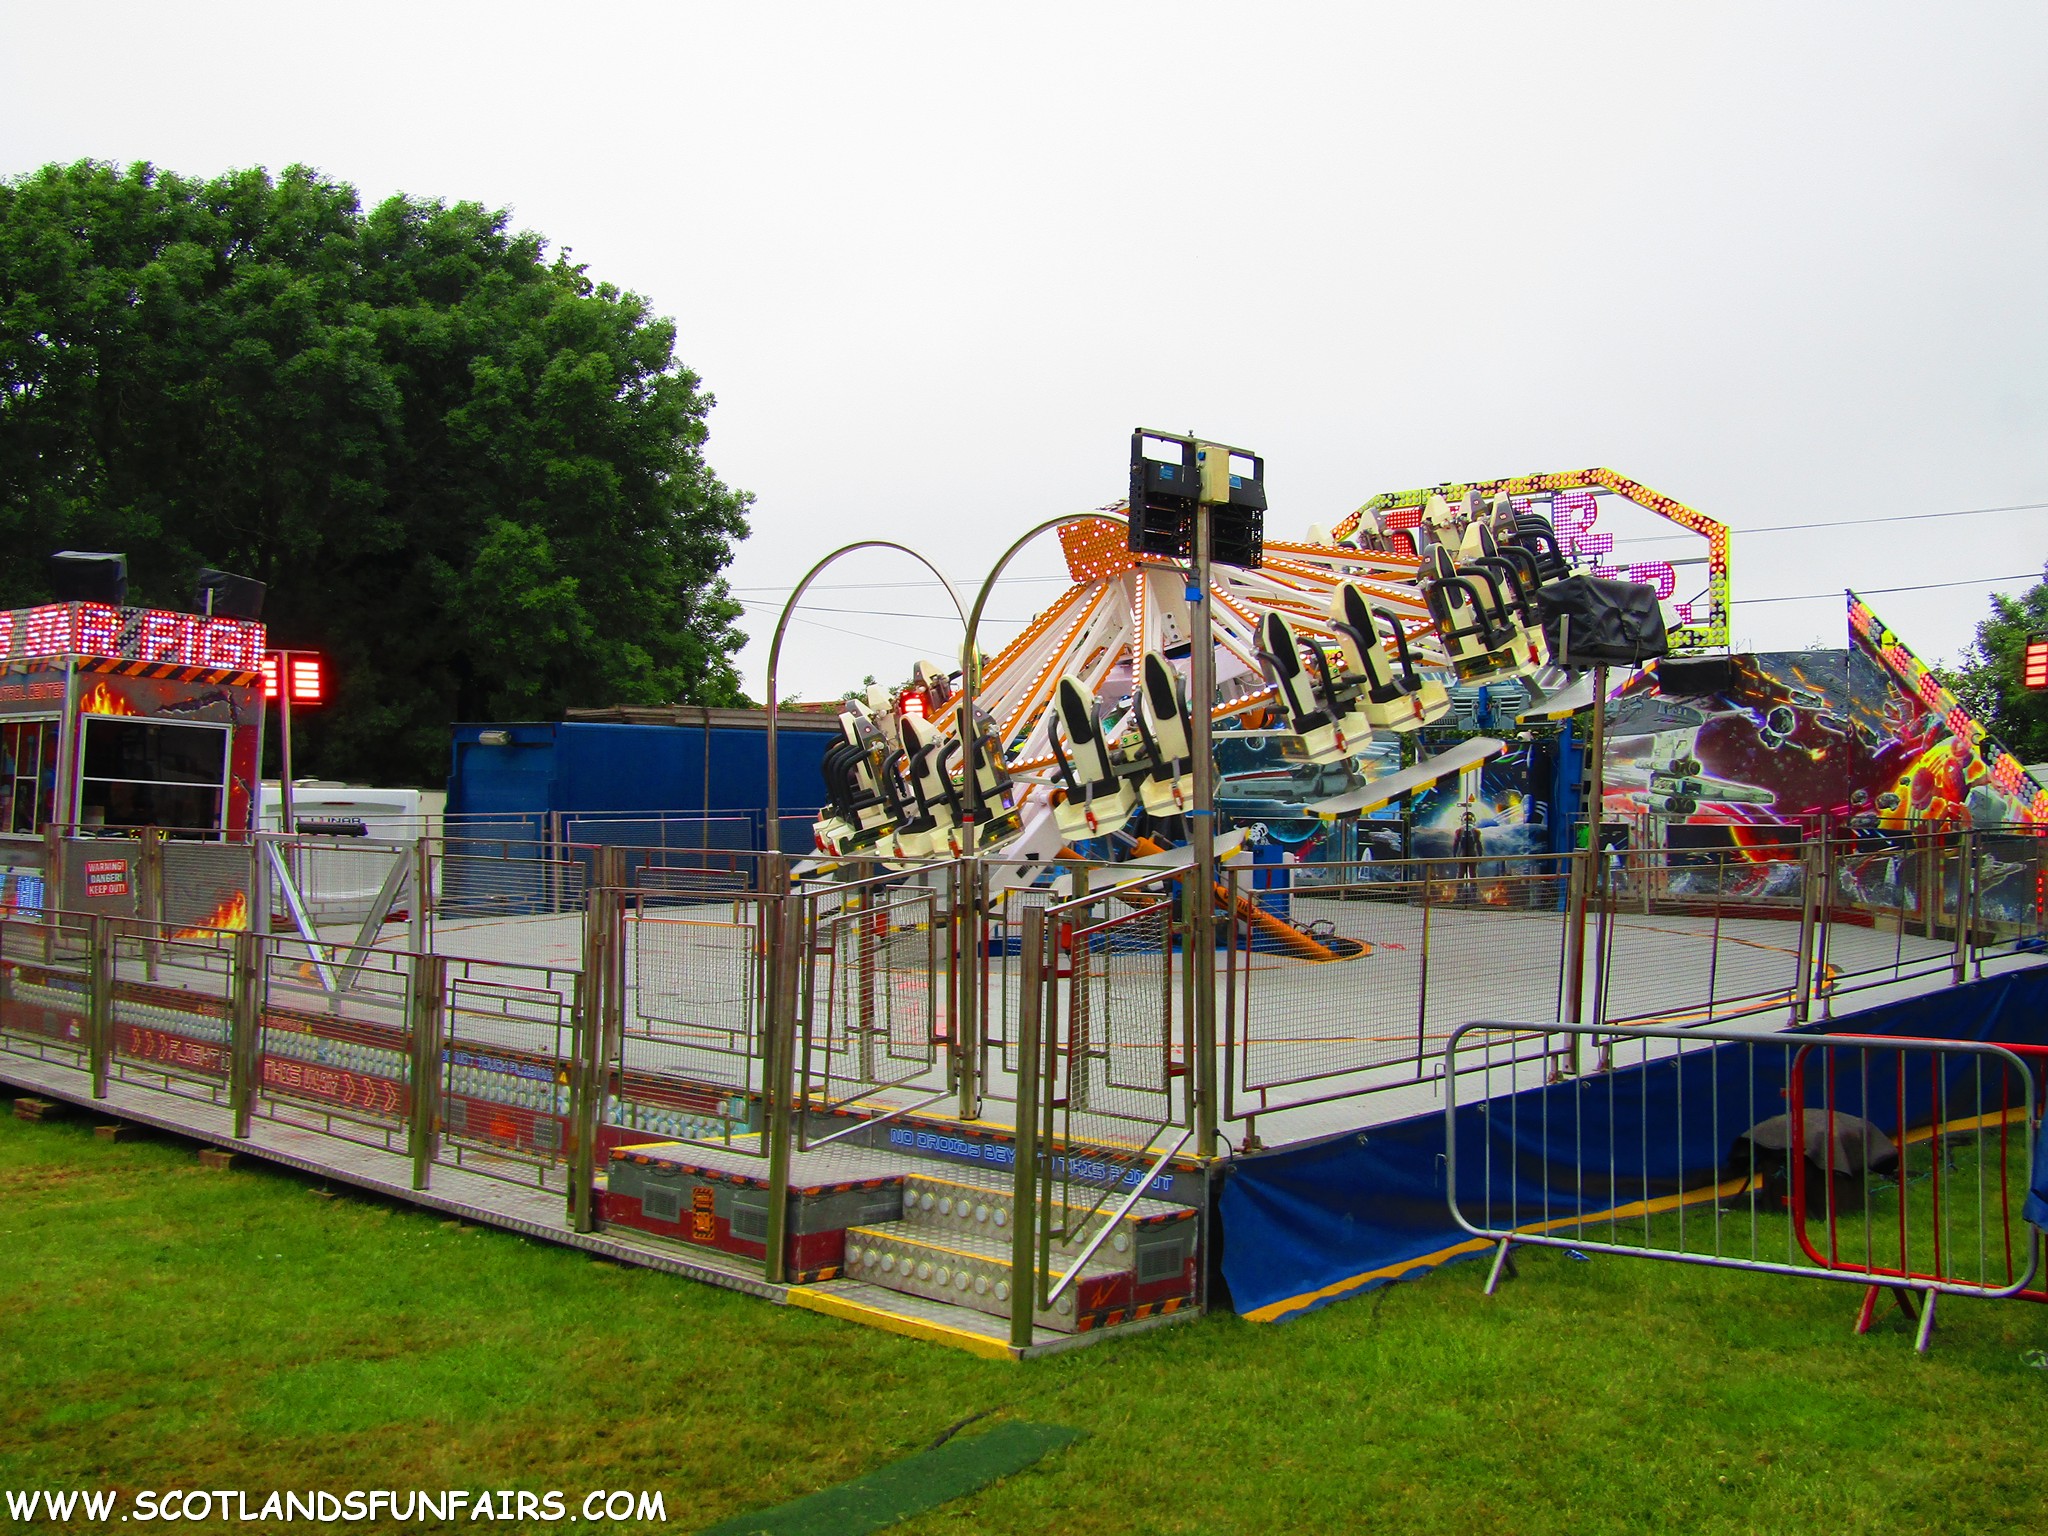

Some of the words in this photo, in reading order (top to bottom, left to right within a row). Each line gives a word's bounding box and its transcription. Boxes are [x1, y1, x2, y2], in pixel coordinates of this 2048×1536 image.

[0, 685, 26, 701] TROL
[88, 861, 124, 872] WARNING!
[91, 873, 122, 883] DANGER!
[89, 884, 107, 895] KEEP
[109, 883, 125, 893] OUT!
[264, 1059, 300, 1086] THIS
[890, 1128, 913, 1146] NO
[916, 1133, 981, 1158] DROIDS
[1057, 1156, 1106, 1179] THIS
